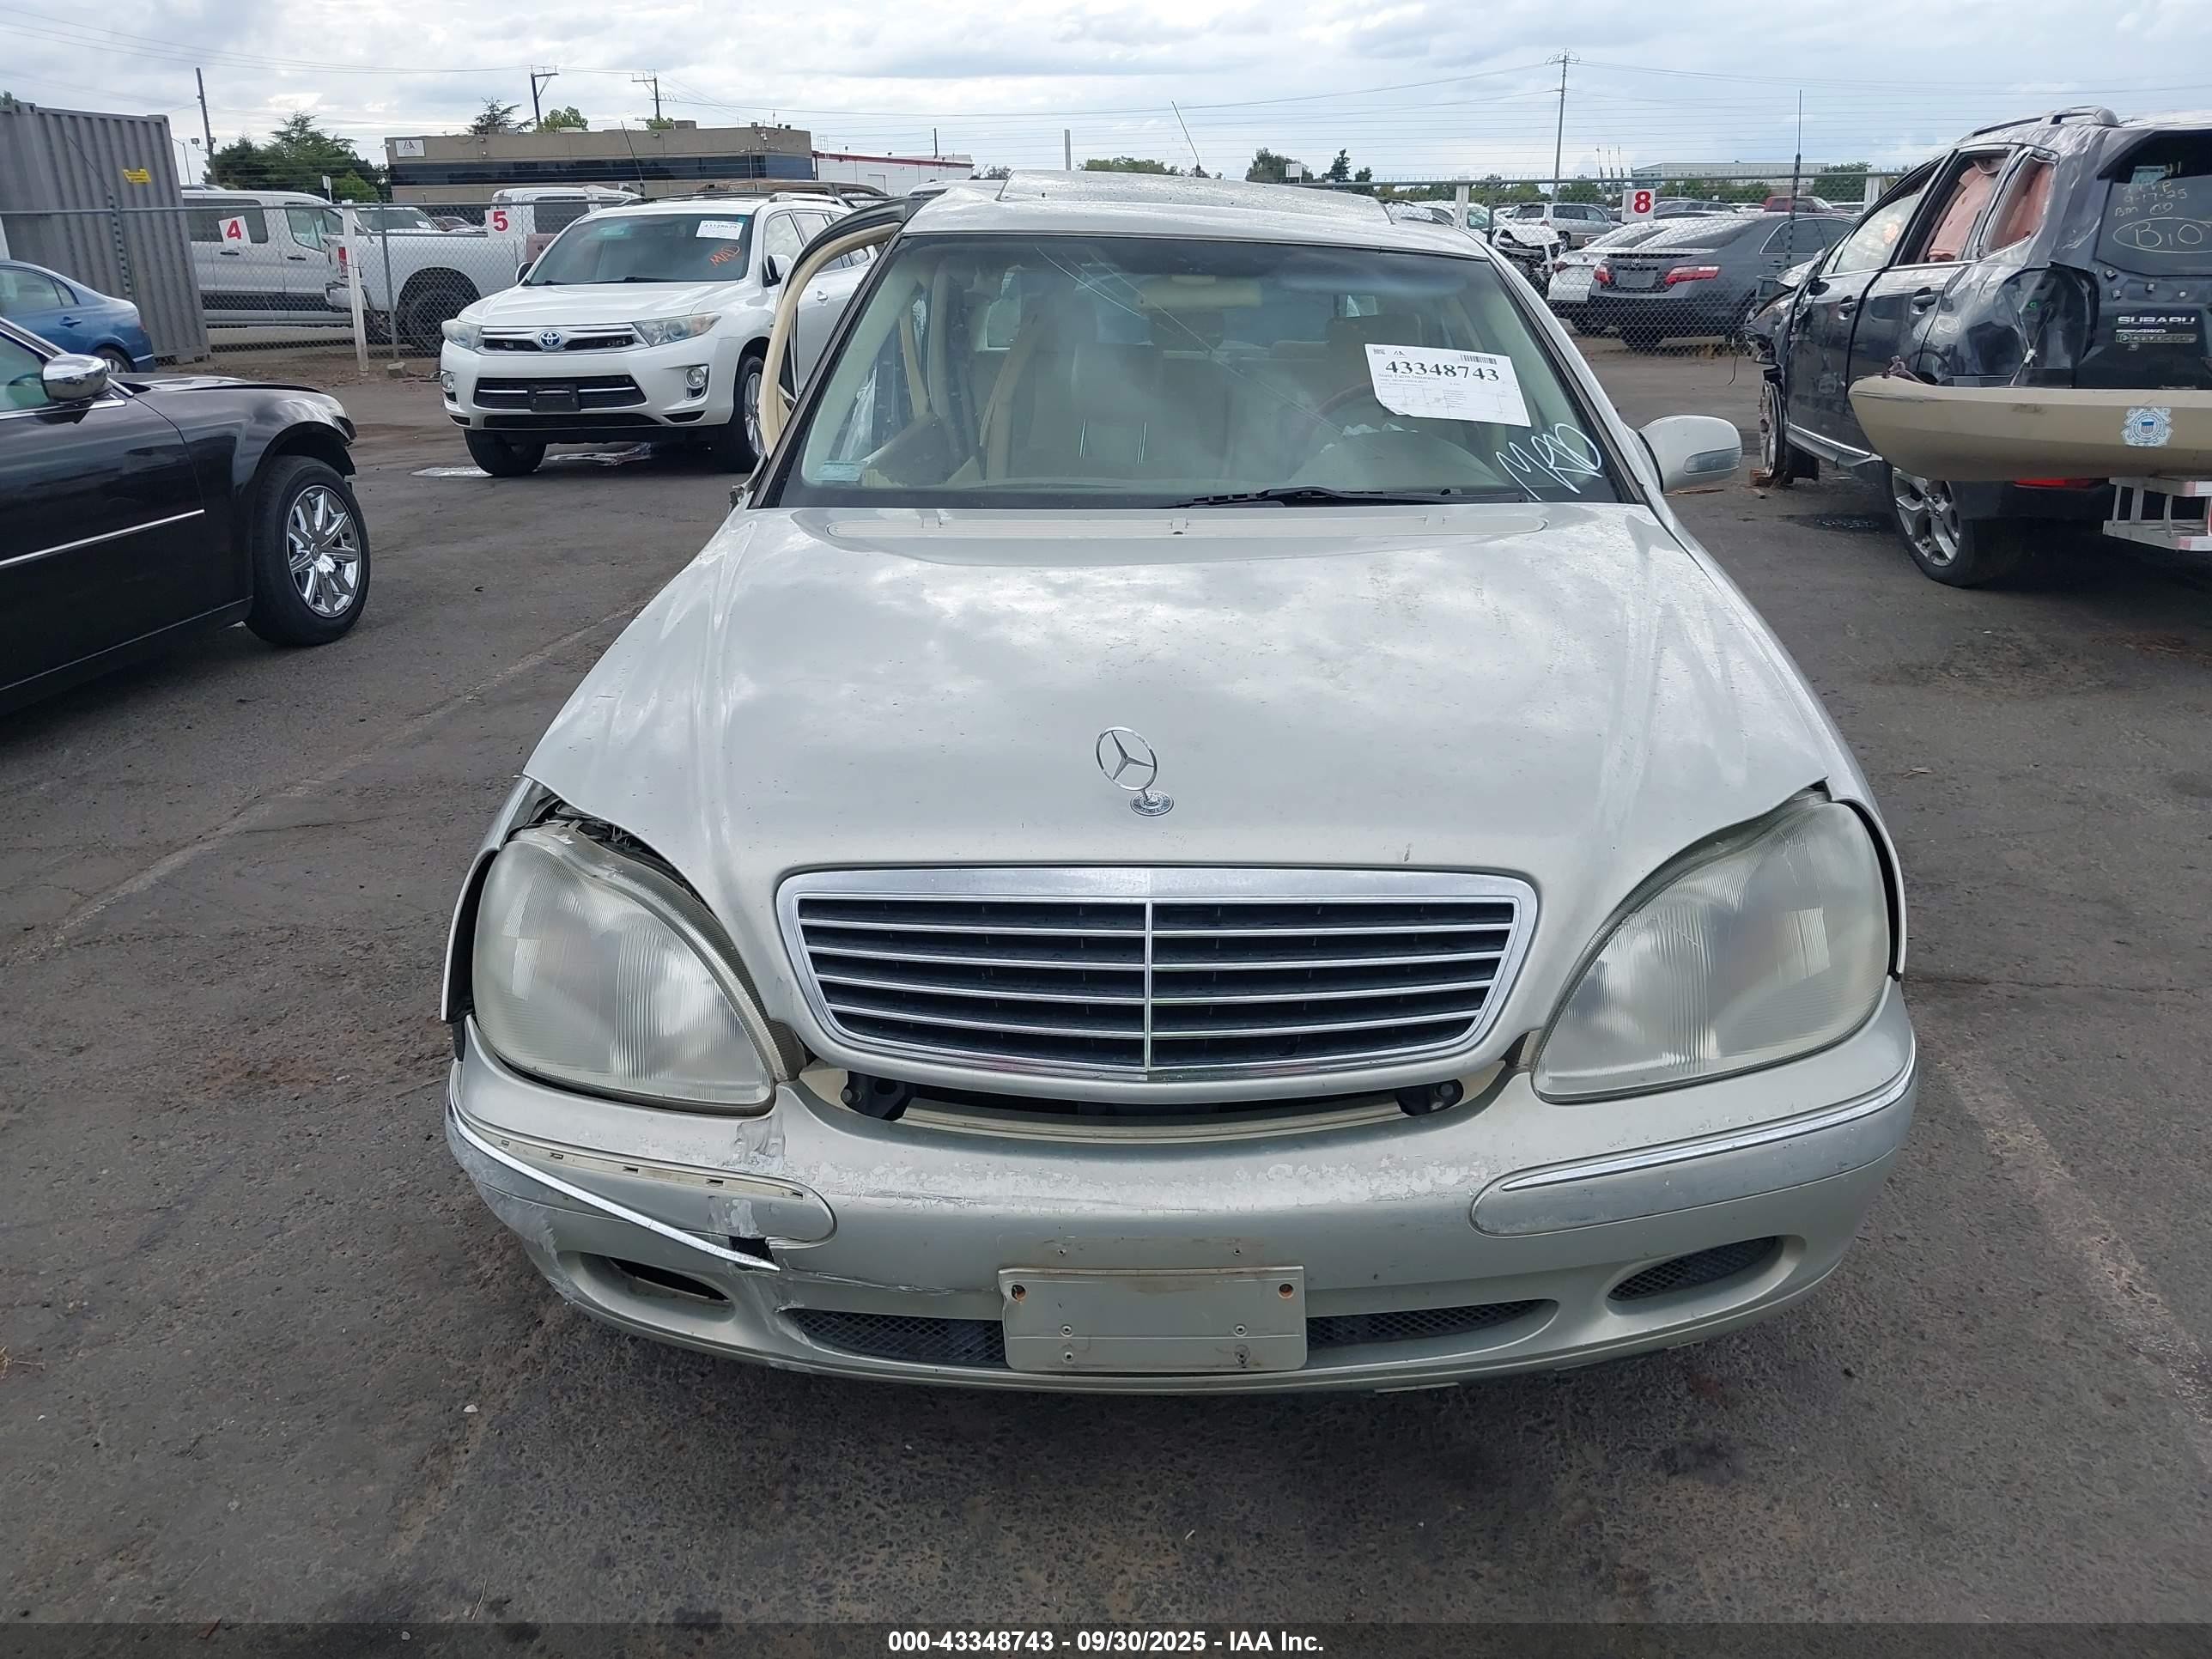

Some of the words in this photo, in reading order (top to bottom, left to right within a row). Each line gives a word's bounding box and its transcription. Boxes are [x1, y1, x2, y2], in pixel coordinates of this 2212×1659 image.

[1633, 191, 1651, 214] 8
[226, 220, 242, 240] 4
[493, 210, 508, 232] 5
[2117, 315, 2196, 325] SUBARU
[1385, 361, 1499, 382] 43348743
